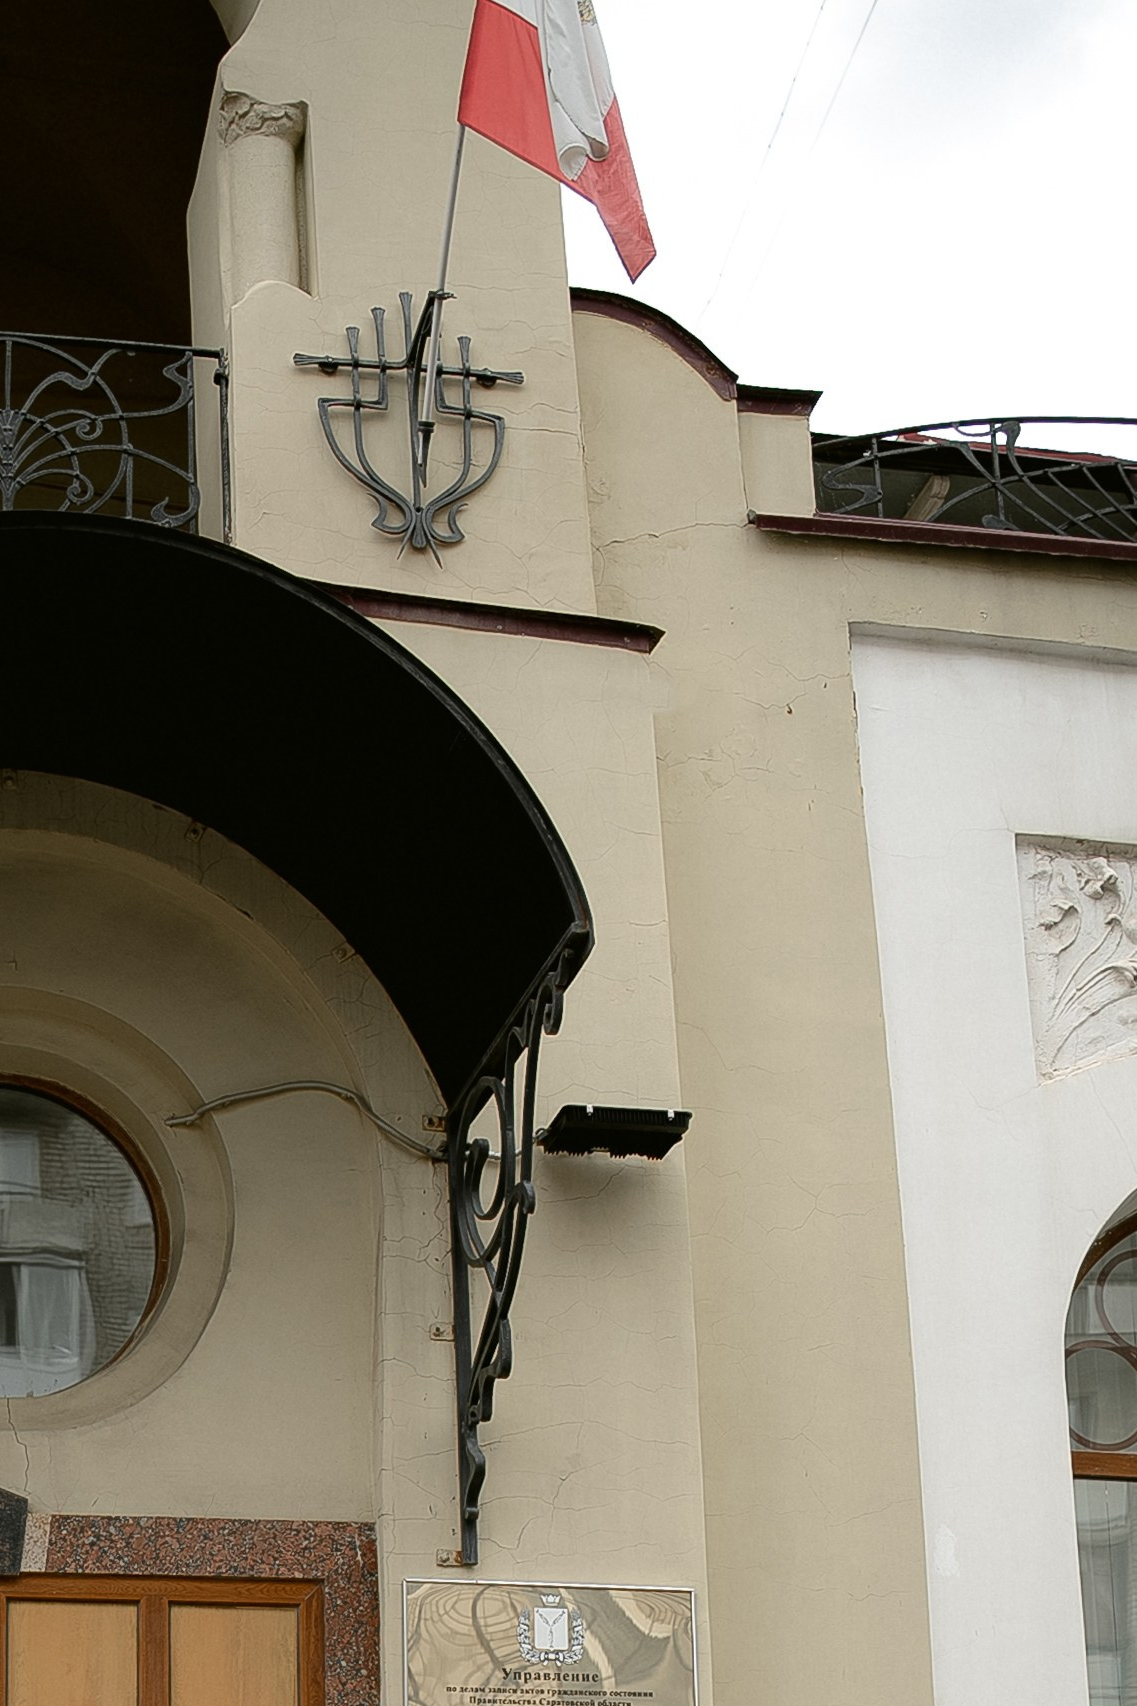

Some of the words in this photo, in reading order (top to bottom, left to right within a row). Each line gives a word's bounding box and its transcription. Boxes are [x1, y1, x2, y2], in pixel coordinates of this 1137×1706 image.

[502, 1667, 600, 1683] Управление
[547, 1688, 607, 1697] гражданского
[469, 1696, 537, 1705] Правительства
